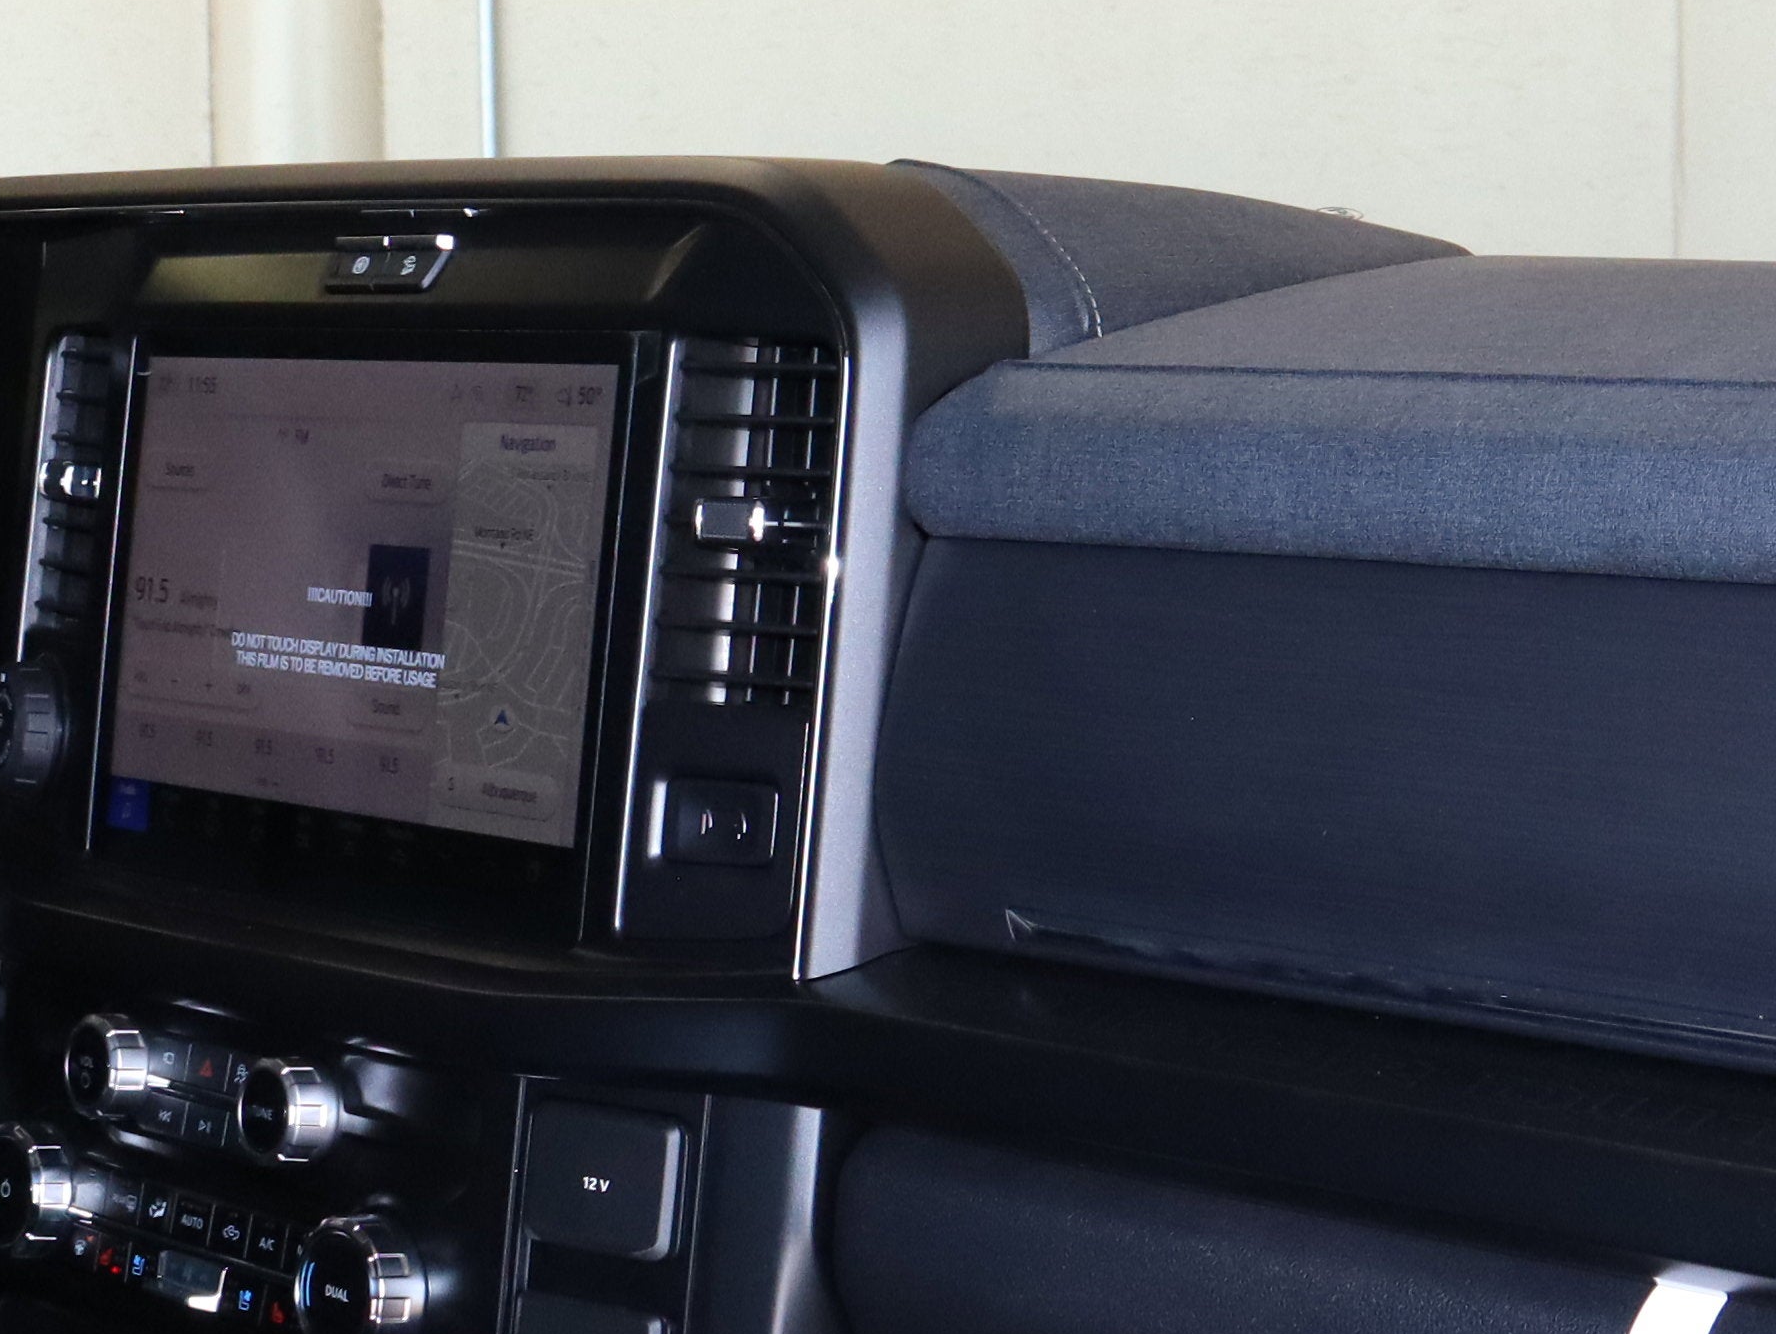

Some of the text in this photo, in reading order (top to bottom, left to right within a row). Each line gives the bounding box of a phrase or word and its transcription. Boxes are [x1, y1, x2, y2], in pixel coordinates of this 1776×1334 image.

[501, 434, 556, 454] Navigation
[135, 575, 169, 603] 91.5
[231, 631, 445, 669] DO NOT TOUCH DISPLAY DURING INSTALLATION
[236, 650, 257, 667] THIS
[257, 652, 279, 669] FILM
[279, 655, 289, 669] IS
[290, 656, 303, 672] TO
[304, 657, 317, 673] BE
[318, 660, 364, 679] REMOVED
[364, 665, 403, 684] BEFORE
[403, 670, 437, 688] USAGE
[582, 1176, 610, 1193] 12 V
[180, 1213, 204, 1230] AUTO
[258, 1236, 276, 1252] A/C
[325, 1283, 350, 1304] DUAL
